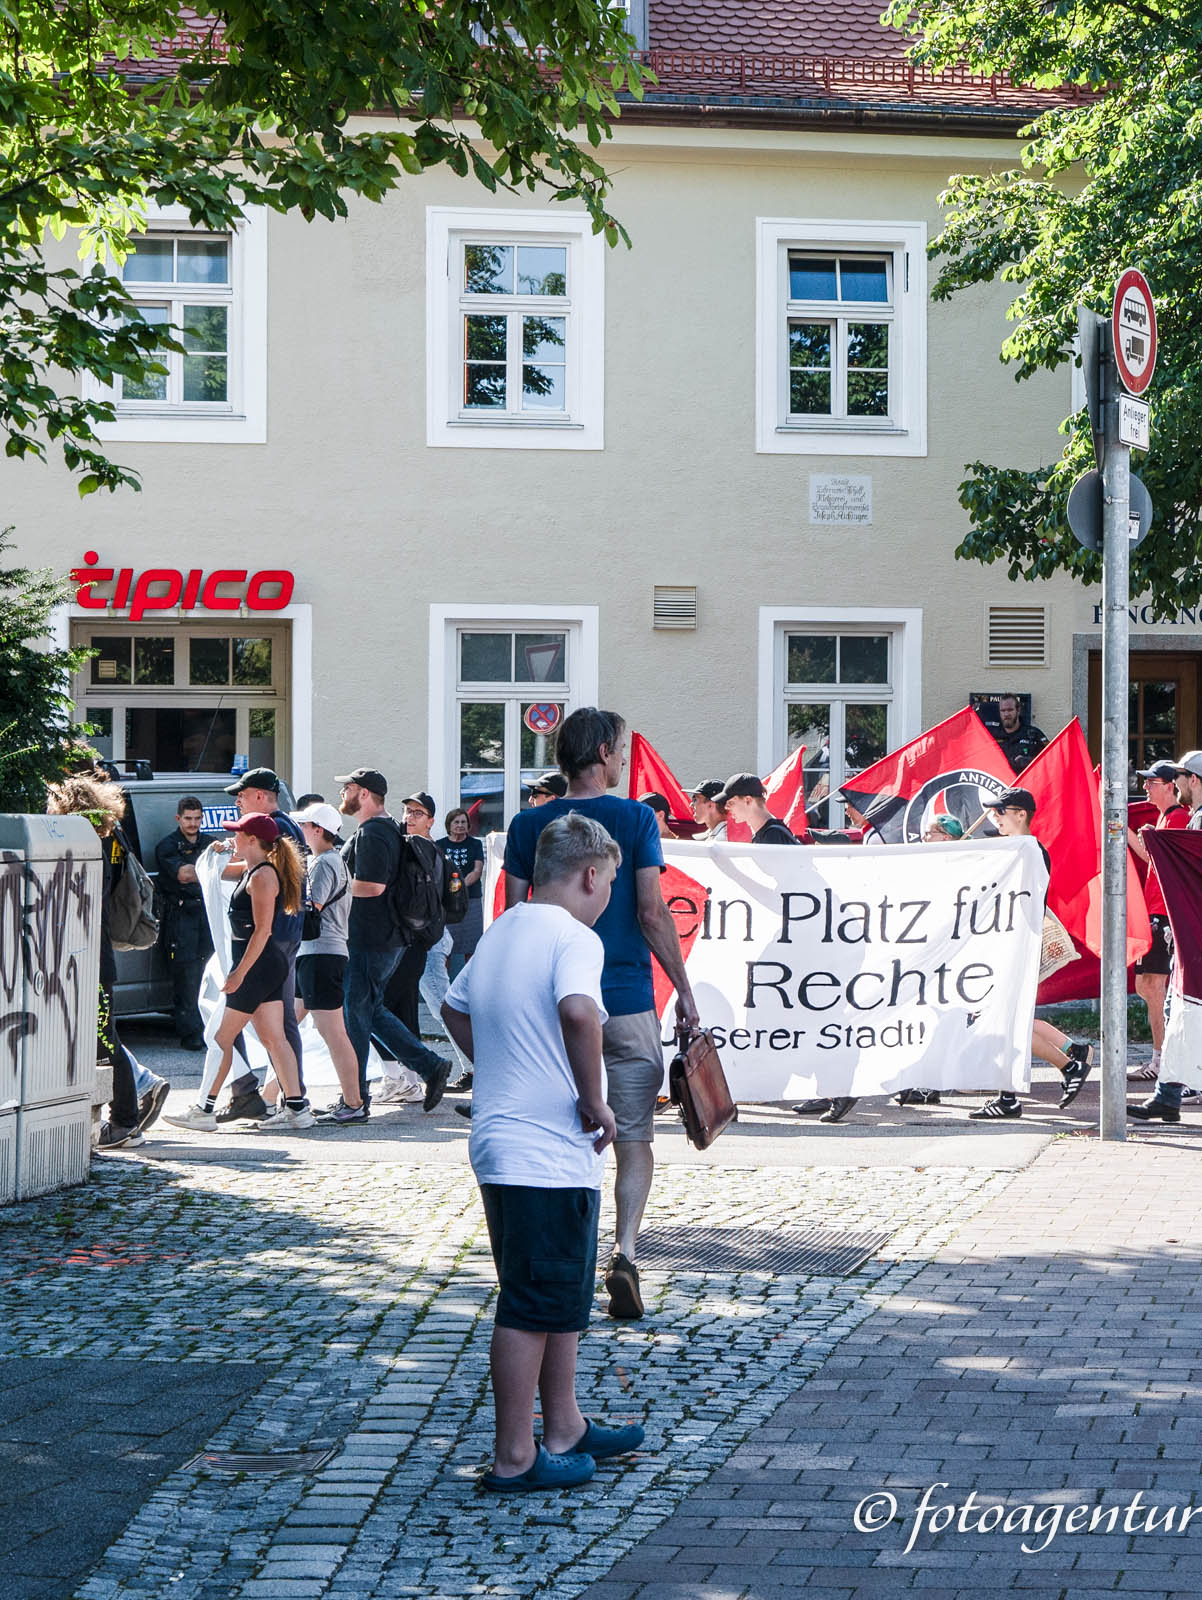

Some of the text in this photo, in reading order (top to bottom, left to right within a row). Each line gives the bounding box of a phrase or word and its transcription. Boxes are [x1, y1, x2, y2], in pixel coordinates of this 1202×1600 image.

[70, 551, 294, 621] tipico
[200, 809, 239, 828] OLIZEI
[666, 882, 1032, 944] ein Platz für
[743, 959, 995, 1011] Rechte
[661, 1019, 927, 1051] userer Stadt!
